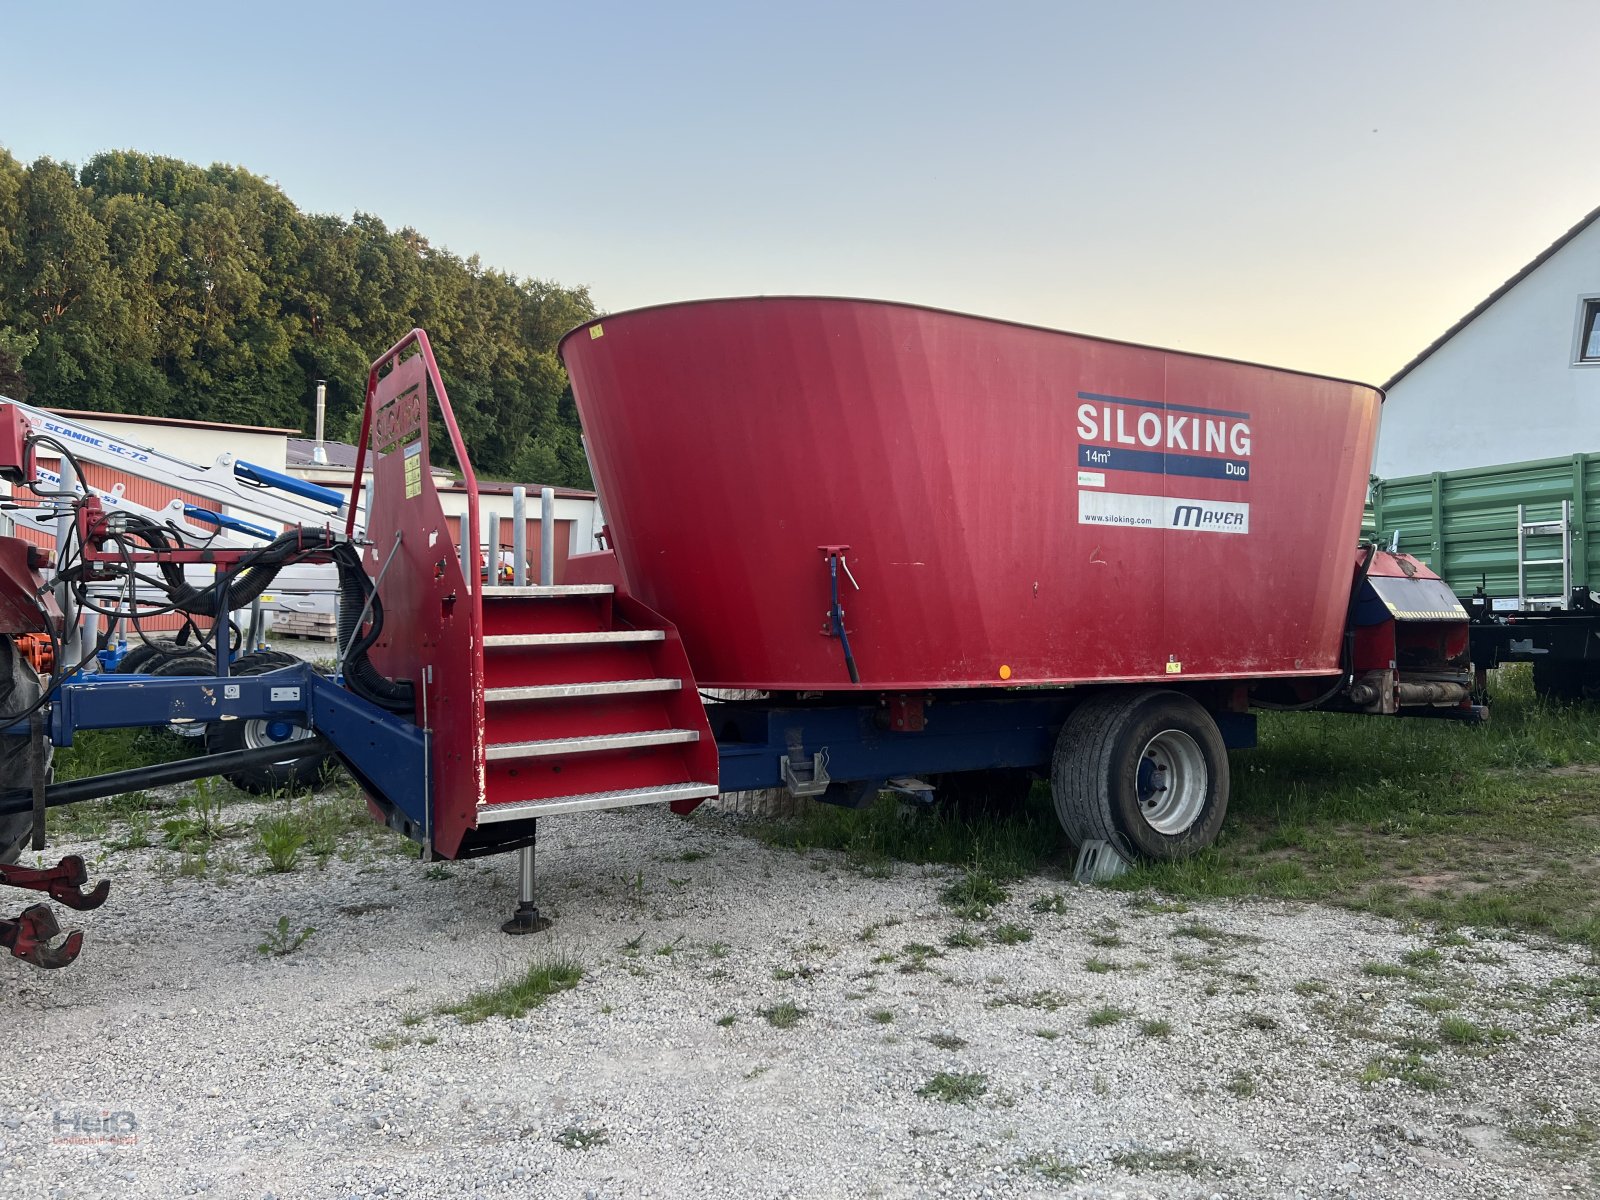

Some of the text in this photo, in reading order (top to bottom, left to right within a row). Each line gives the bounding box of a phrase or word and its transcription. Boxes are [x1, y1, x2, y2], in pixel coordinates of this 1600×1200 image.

[1077, 403, 1251, 456] SILOKING
[44, 422, 149, 463] SCANDIC SC-72
[1225, 462, 1246, 476] Duo
[1084, 514, 1152, 526] www.siloking.com
[1172, 505, 1244, 528] MAYER
